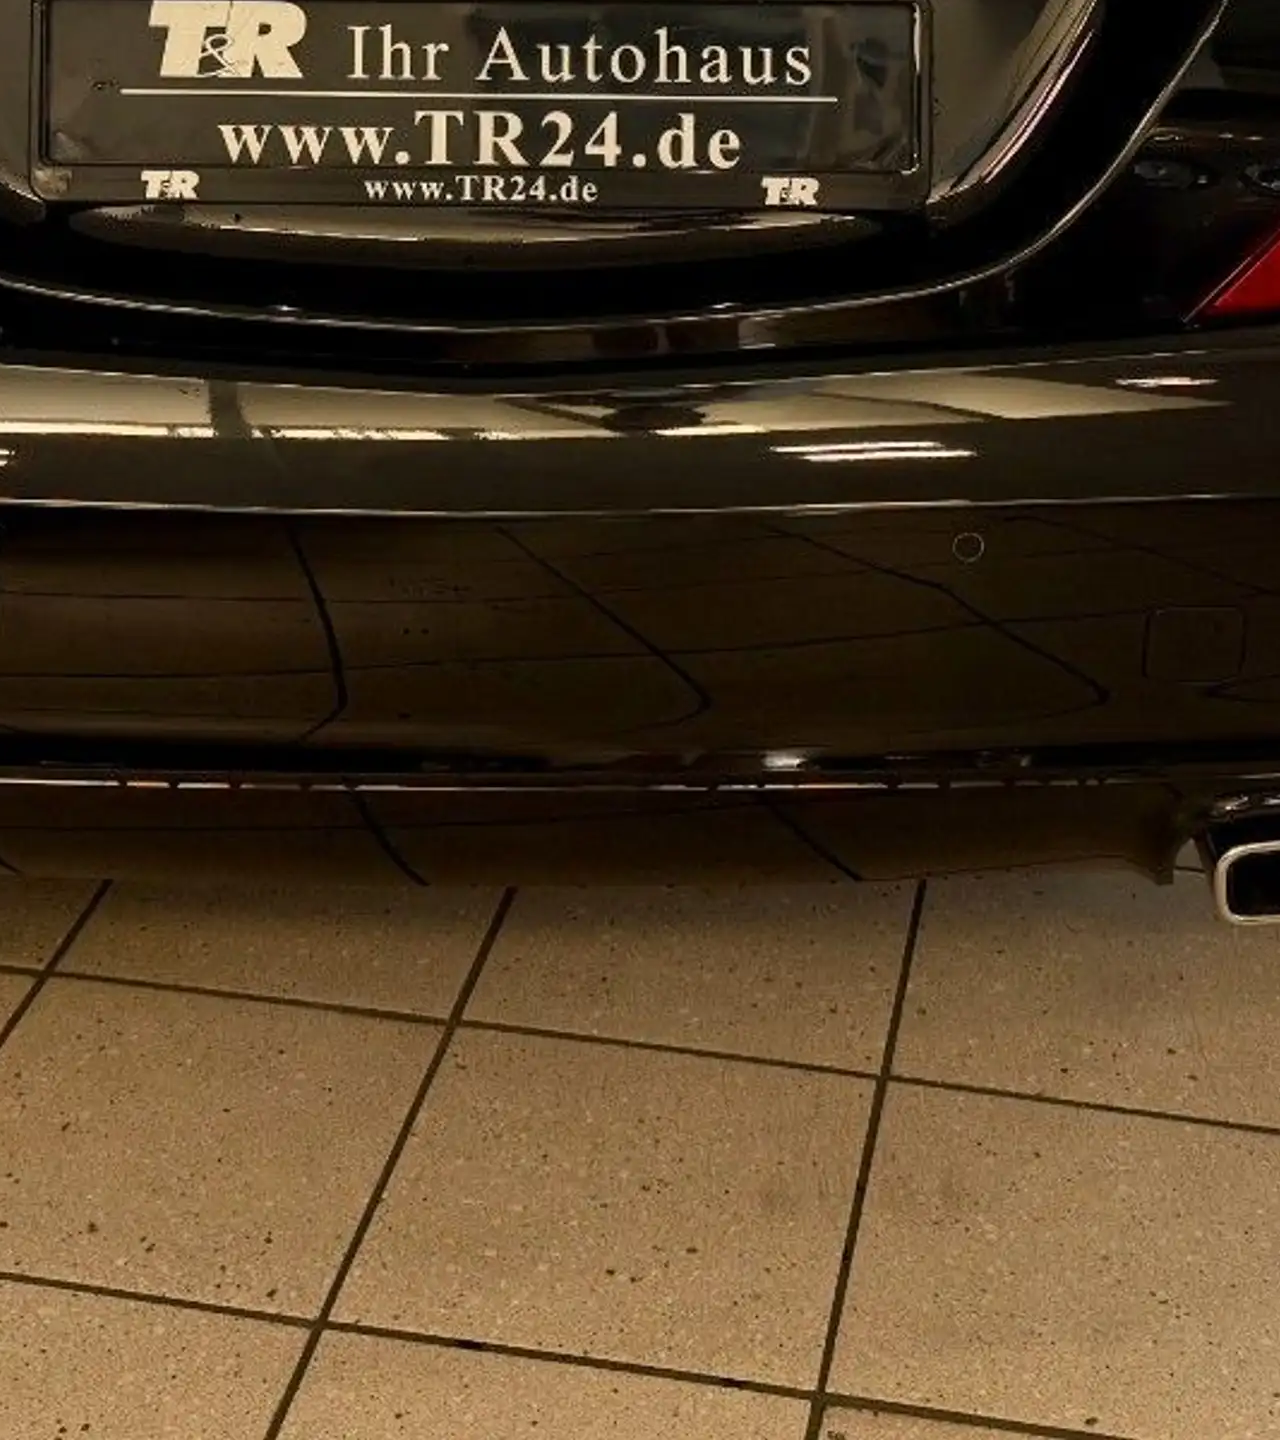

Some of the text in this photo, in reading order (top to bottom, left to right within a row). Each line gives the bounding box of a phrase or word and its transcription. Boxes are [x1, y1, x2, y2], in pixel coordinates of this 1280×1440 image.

[345, 23, 451, 81] Ihr
[473, 25, 813, 87] Autohaus
[217, 109, 742, 170] www.TR24.de
[362, 174, 599, 203] www.TR24.de
